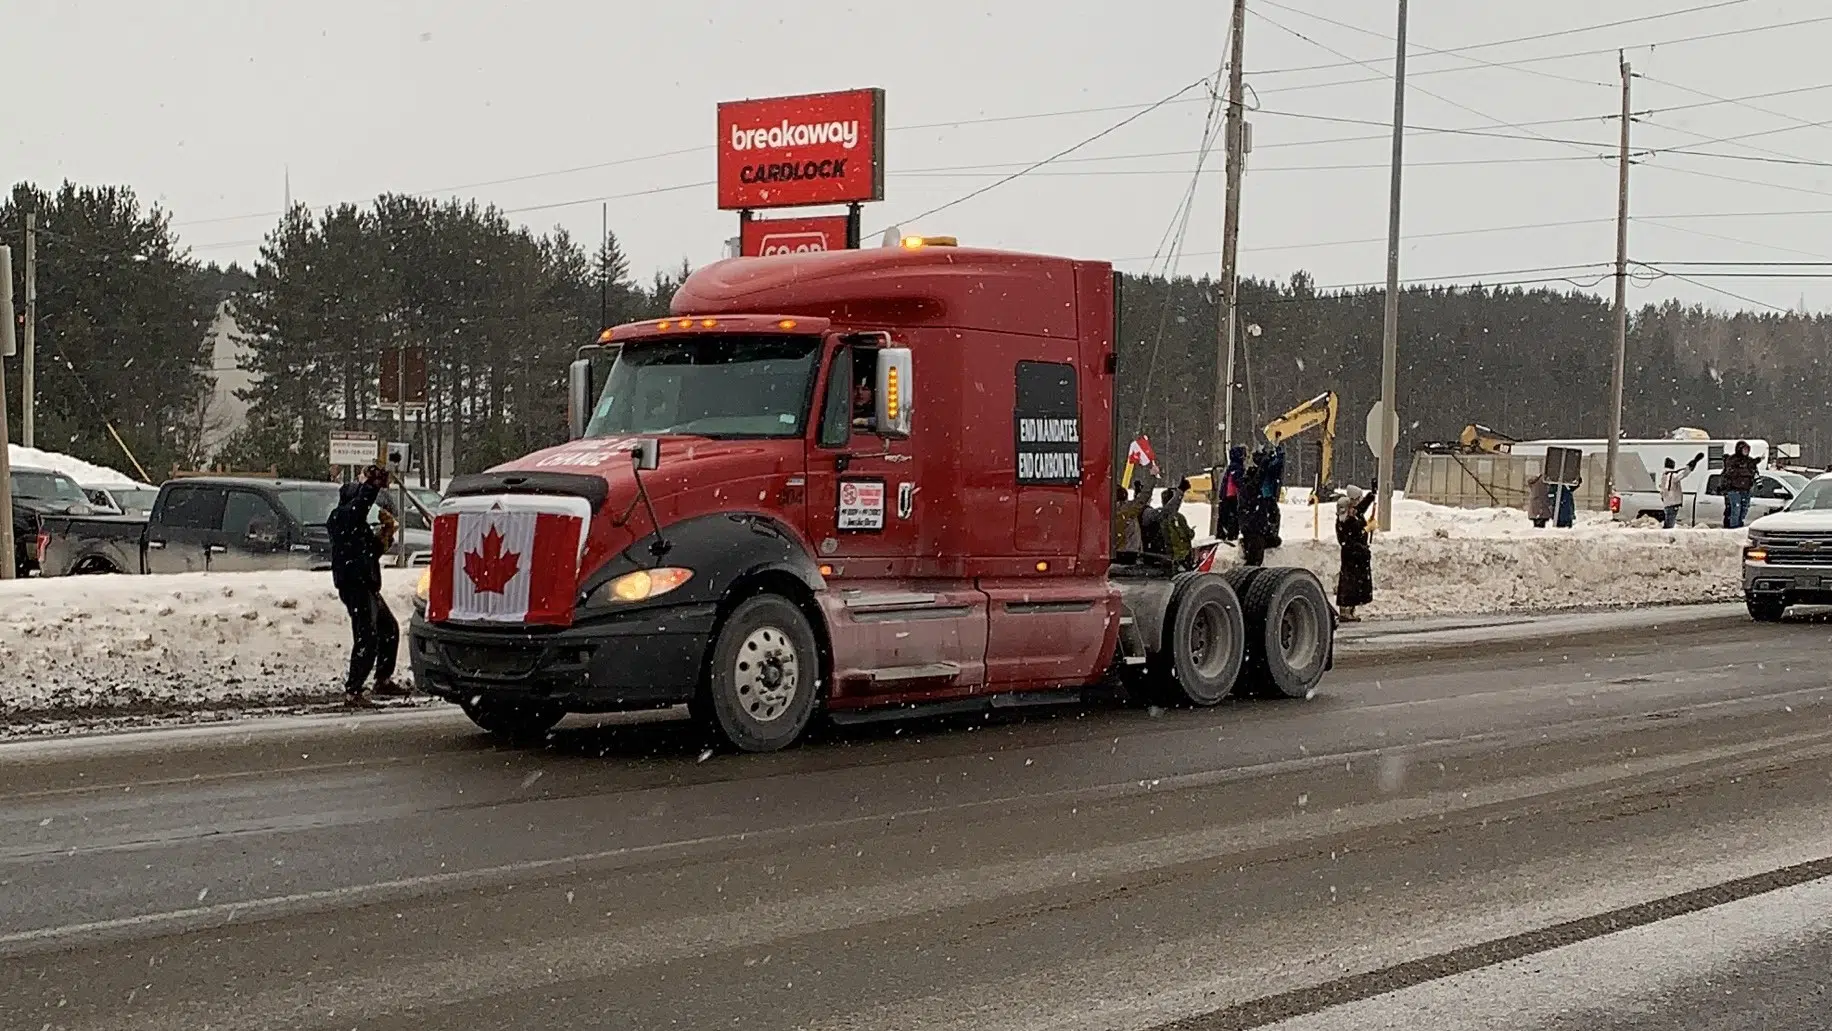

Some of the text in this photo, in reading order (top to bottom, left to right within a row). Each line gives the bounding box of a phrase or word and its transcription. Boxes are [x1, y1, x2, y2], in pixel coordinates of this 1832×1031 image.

[731, 119, 858, 150] breakaway
[740, 158, 848, 184] CARDLOCK
[1019, 418, 1079, 442] END MANDATES
[1018, 452, 1080, 478] END CARBON TAX
